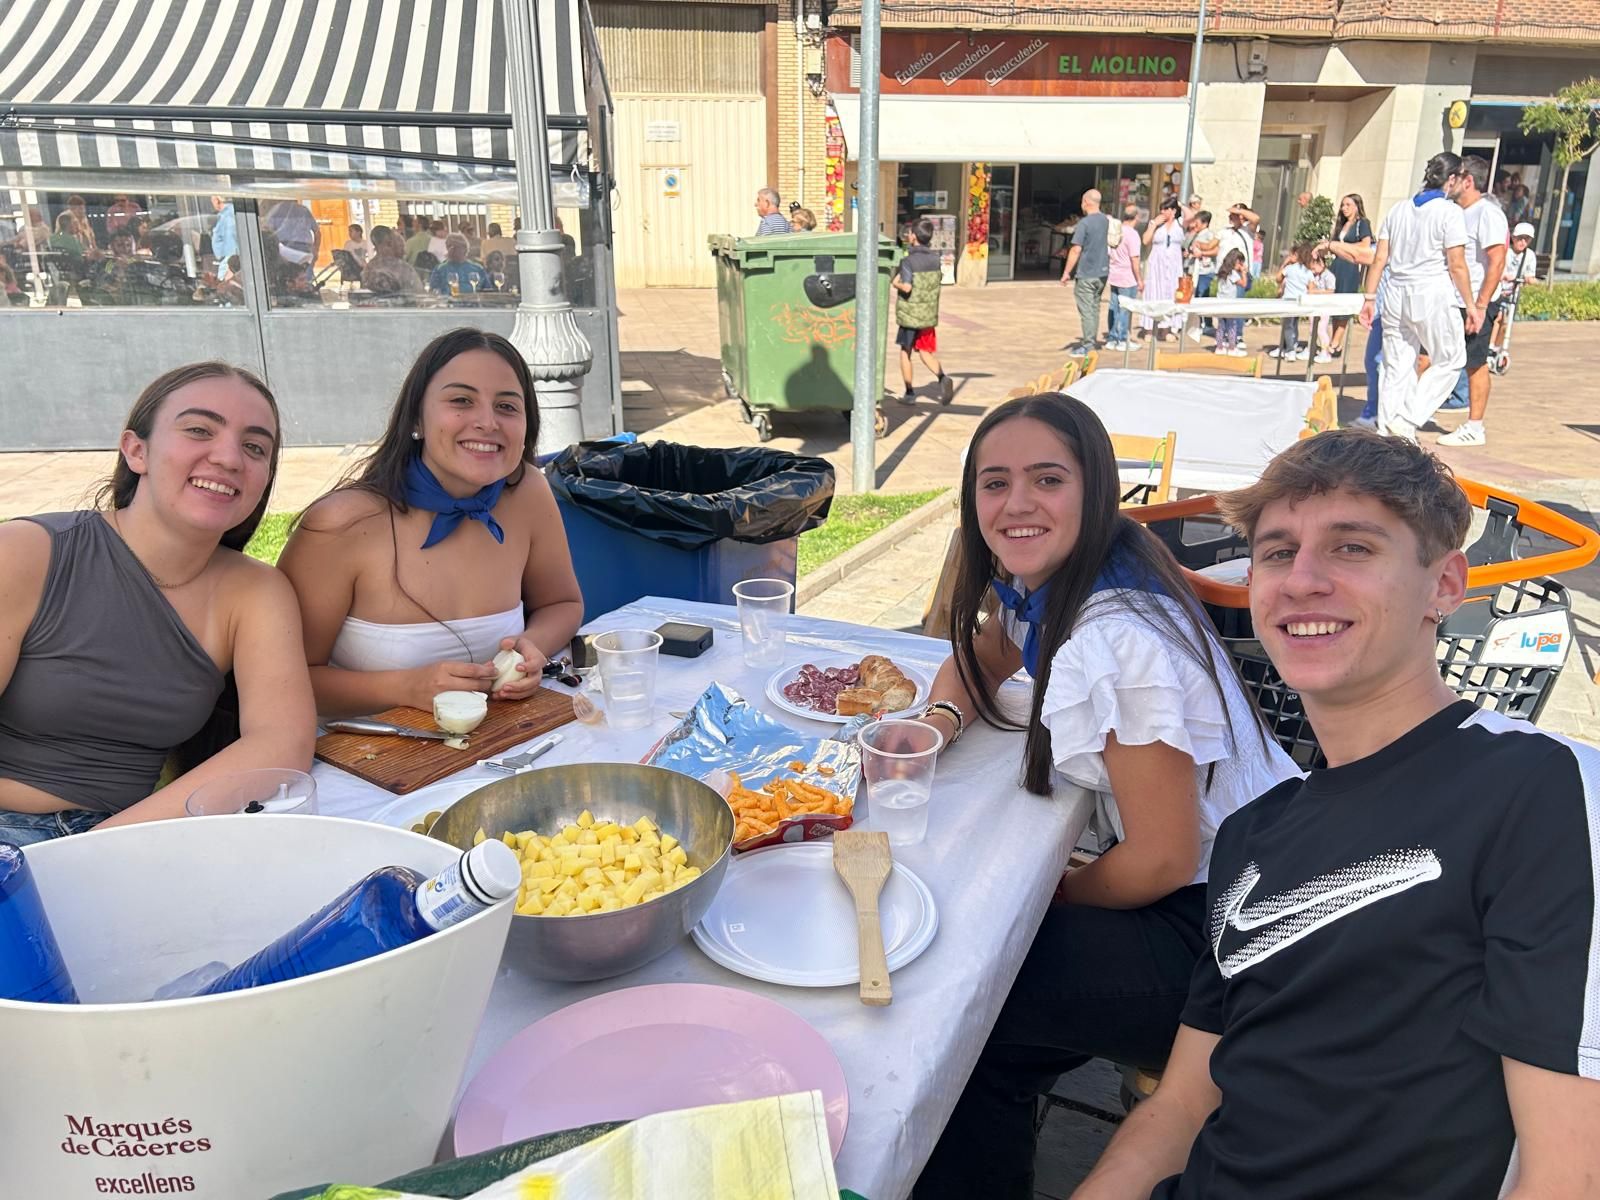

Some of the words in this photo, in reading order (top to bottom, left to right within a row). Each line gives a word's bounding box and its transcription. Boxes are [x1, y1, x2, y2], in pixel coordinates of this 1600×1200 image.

[1058, 55, 1082, 74] EL
[1090, 55, 1177, 75] MOLINO
[1520, 632, 1562, 651] lupa
[64, 1114, 193, 1142] Marqués
[61, 1137, 90, 1155] de
[91, 1137, 212, 1157] Cáceres
[95, 1172, 196, 1194] excellens
